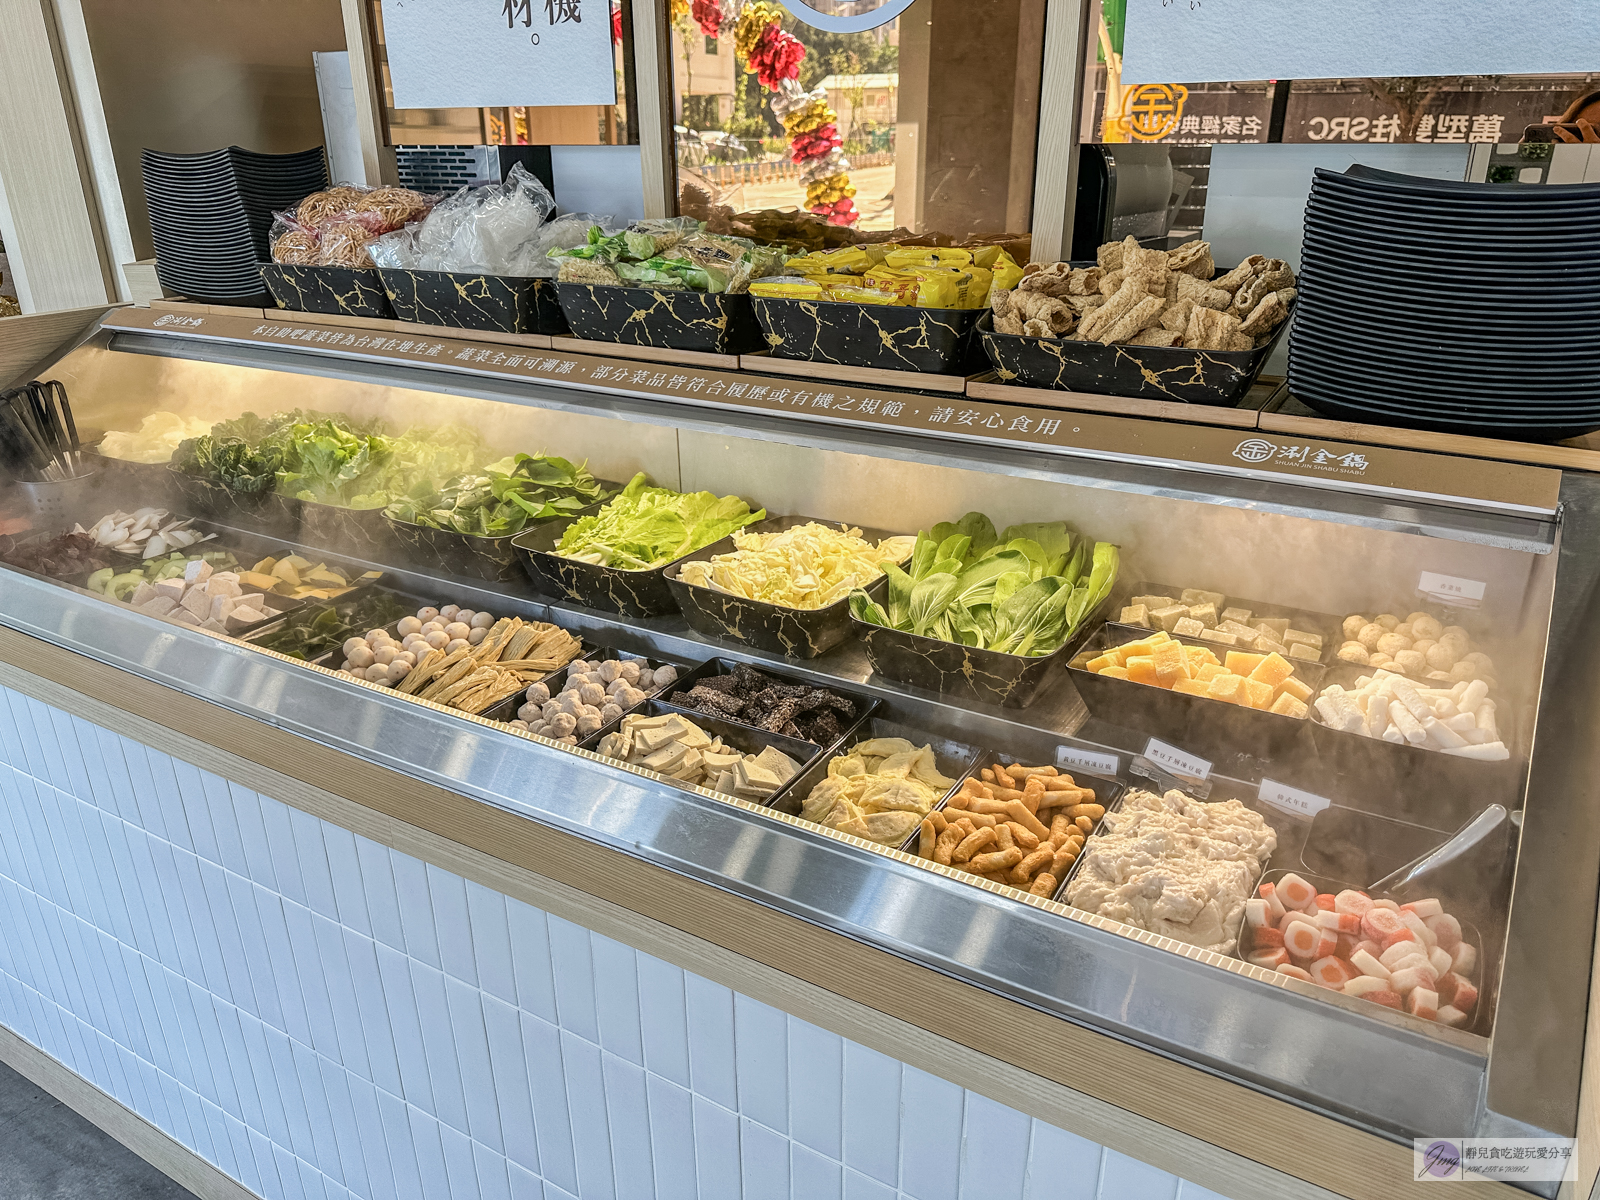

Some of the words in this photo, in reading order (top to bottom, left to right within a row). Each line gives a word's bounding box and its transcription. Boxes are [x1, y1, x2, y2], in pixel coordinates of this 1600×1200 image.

[1274, 460, 1300, 468] SHUAN
[1313, 464, 1339, 473] SHABU
[1340, 468, 1366, 476] SHABU
[1277, 445, 1370, 471] 涮金鍋
